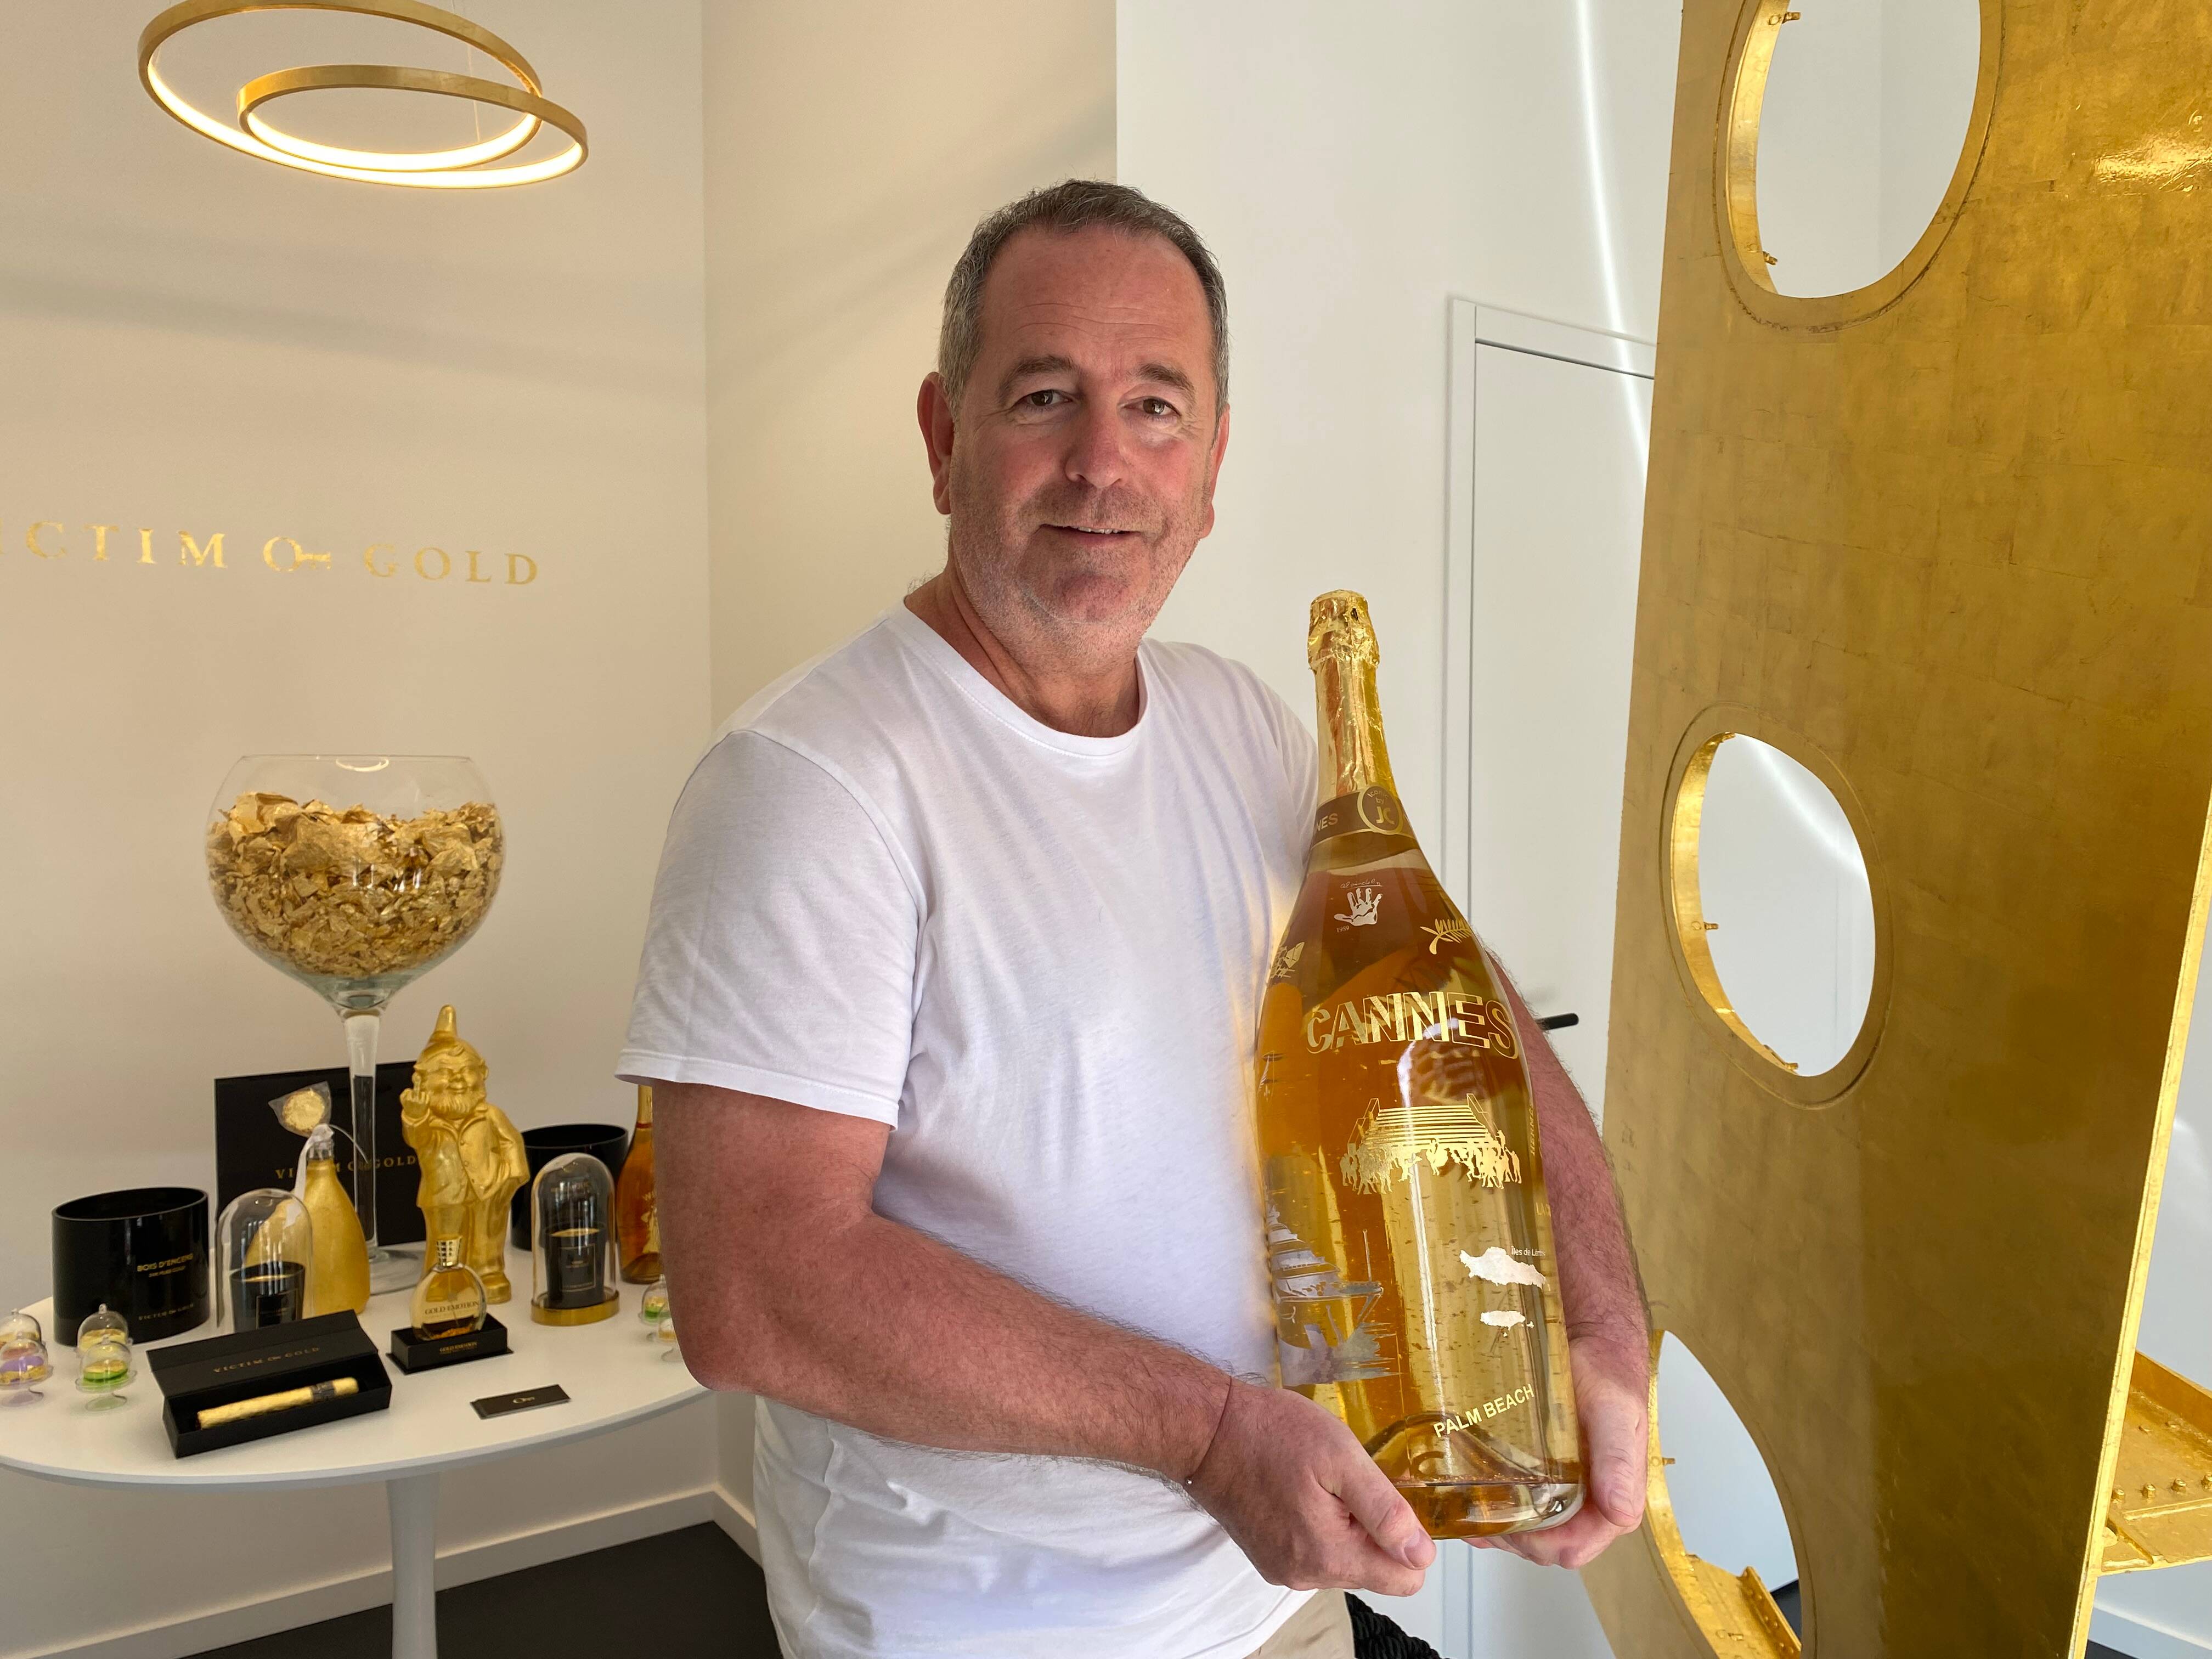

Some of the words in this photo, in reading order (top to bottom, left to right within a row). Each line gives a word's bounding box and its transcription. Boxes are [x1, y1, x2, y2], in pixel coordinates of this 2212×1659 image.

[0, 518, 228, 568] CTIM
[364, 543, 538, 585] GOLD
[1307, 991, 1519, 1059] CANNES
[137, 1262, 157, 1272] BOIS
[1523, 1248, 1531, 1256] de
[425, 1306, 446, 1315] GOLD
[1433, 1407, 1482, 1438] PALM
[1482, 1383, 1535, 1418] BEACH
